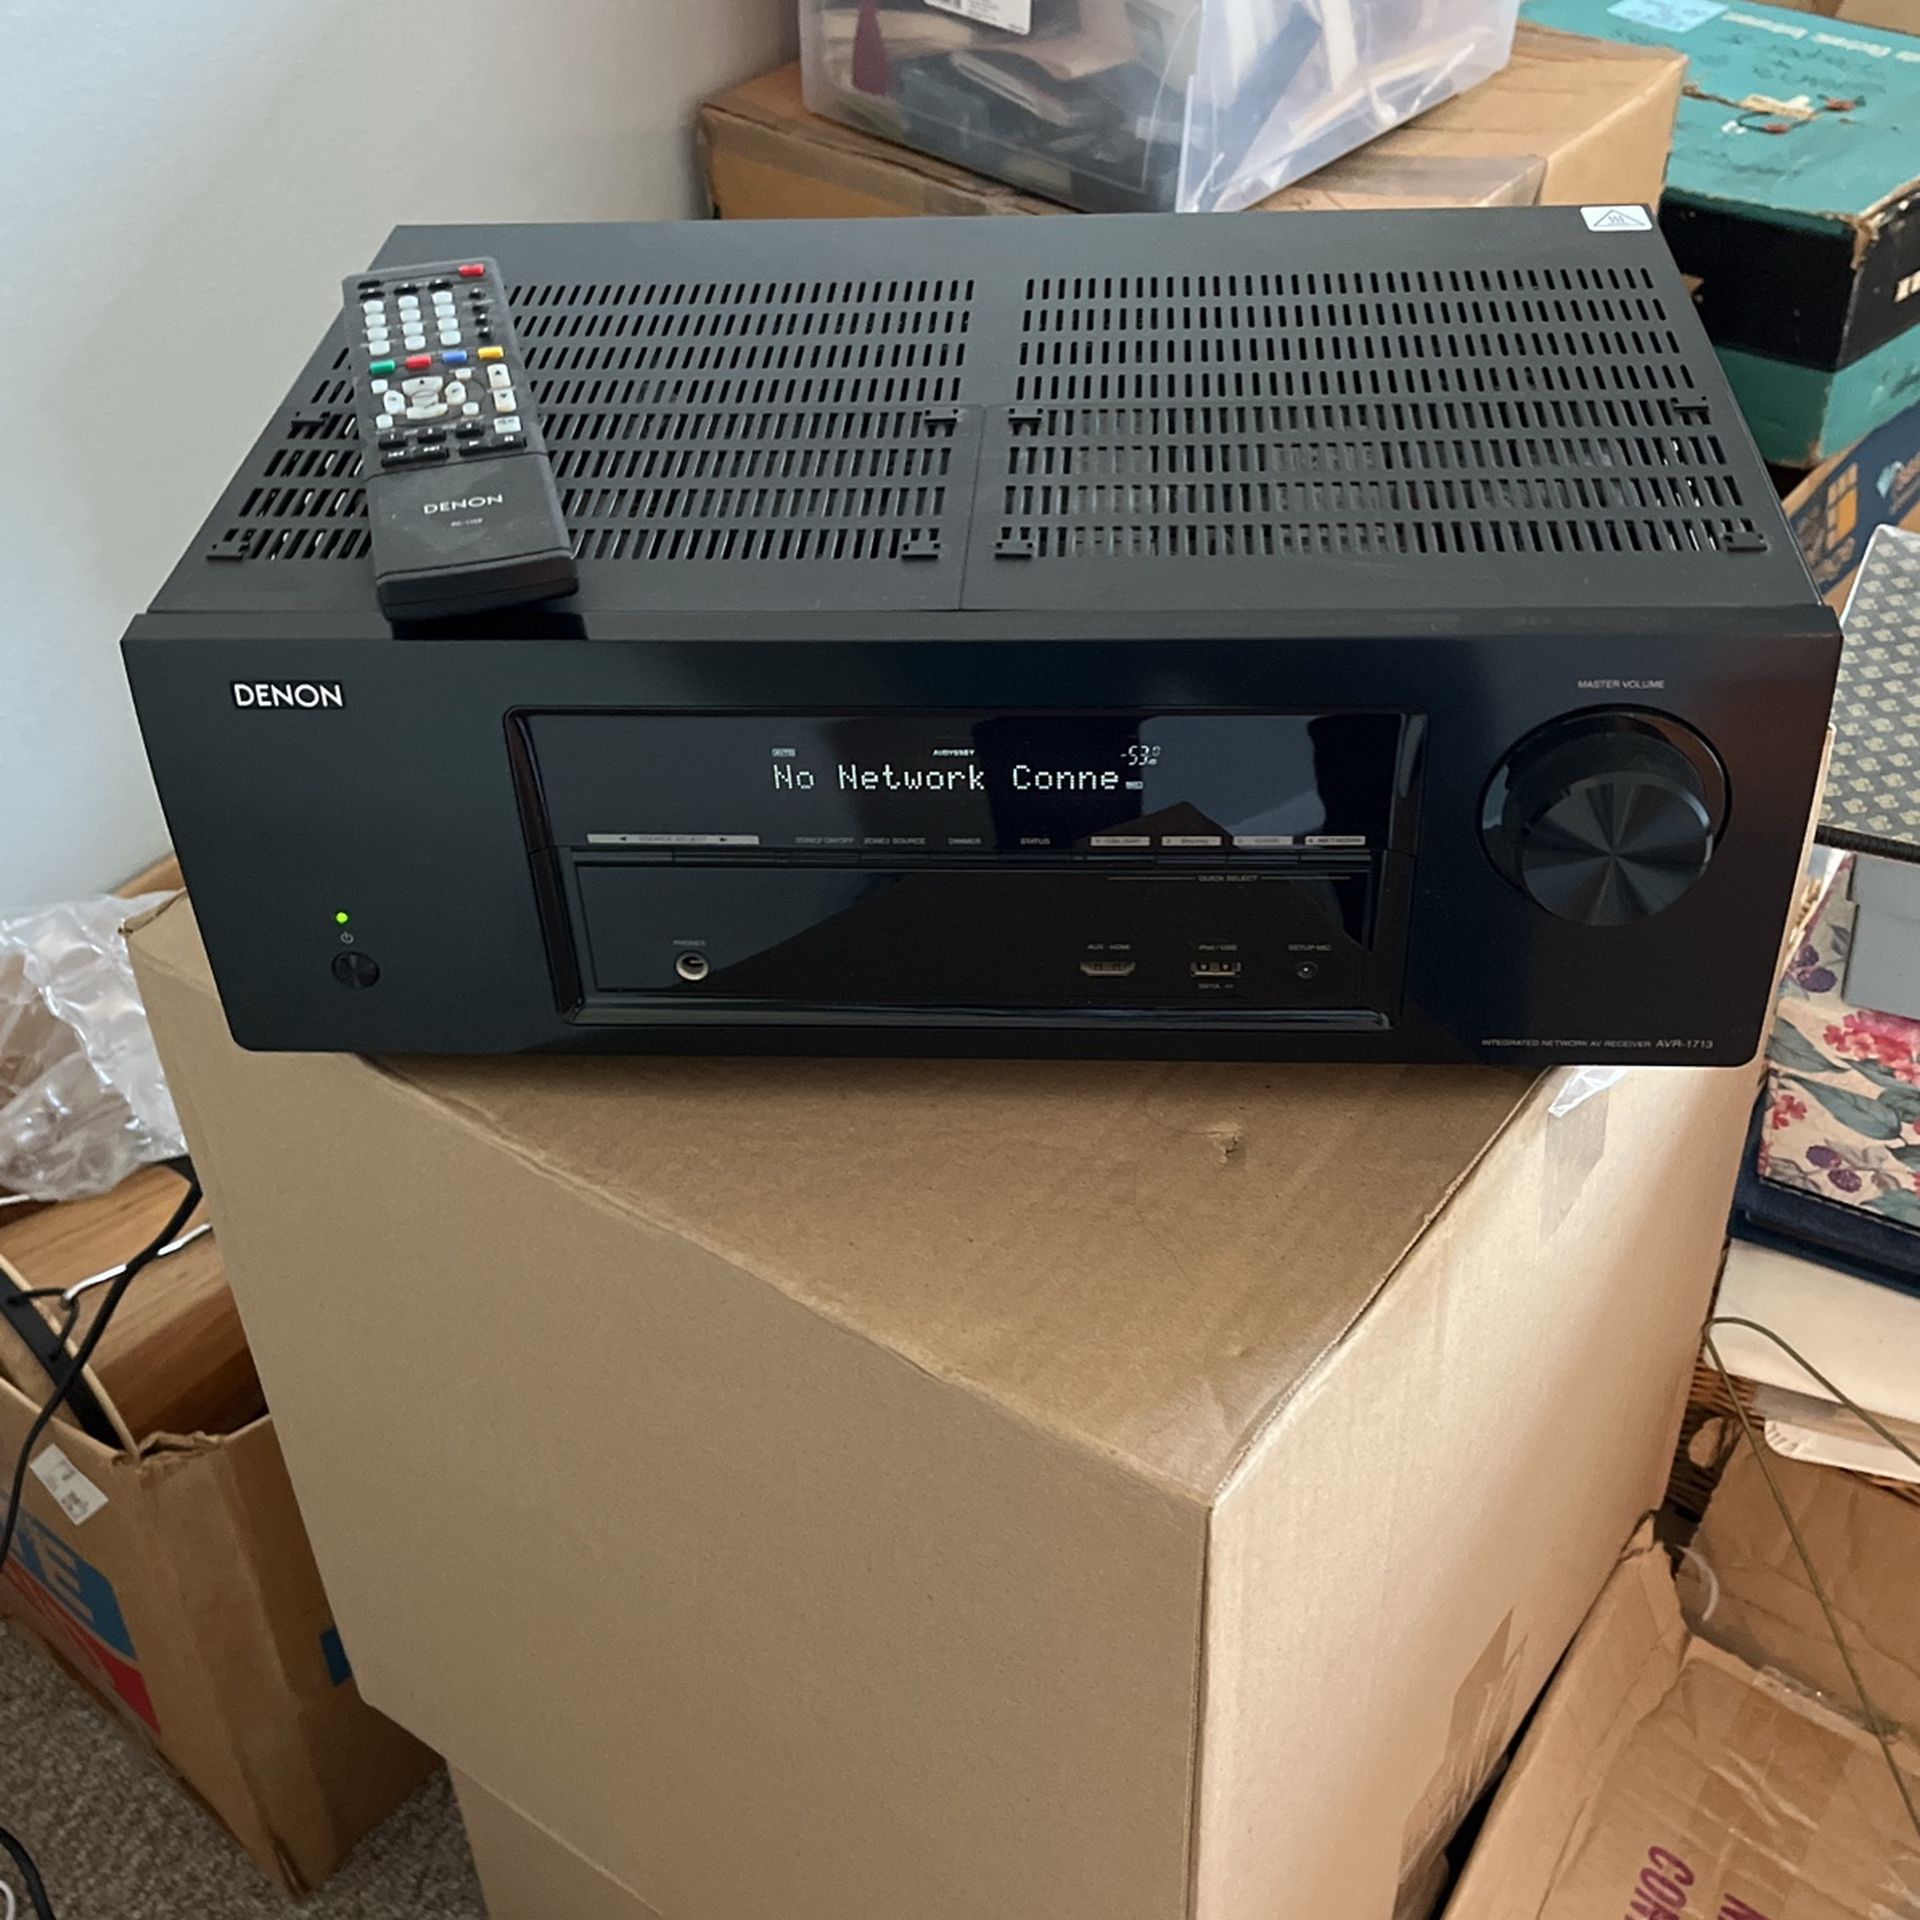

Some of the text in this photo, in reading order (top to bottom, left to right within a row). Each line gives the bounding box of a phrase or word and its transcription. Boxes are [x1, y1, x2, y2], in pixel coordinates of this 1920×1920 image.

[423, 494, 503, 515] DENON
[1577, 679, 1664, 689] MASTER VOLUME
[233, 683, 343, 708] DENON
[932, 748, 975, 757] AUDYSSEY
[773, 764, 1119, 790] No Network Conne
[1020, 837, 1051, 845] STATUS
[1226, 874, 1258, 882] SELECT
[1481, 1038, 1540, 1048] INTEGRATED
[1541, 1039, 1588, 1048] NETWORK
[1603, 1039, 1652, 1049] RECEIVER
[1655, 1038, 1714, 1050] AVR-1713
